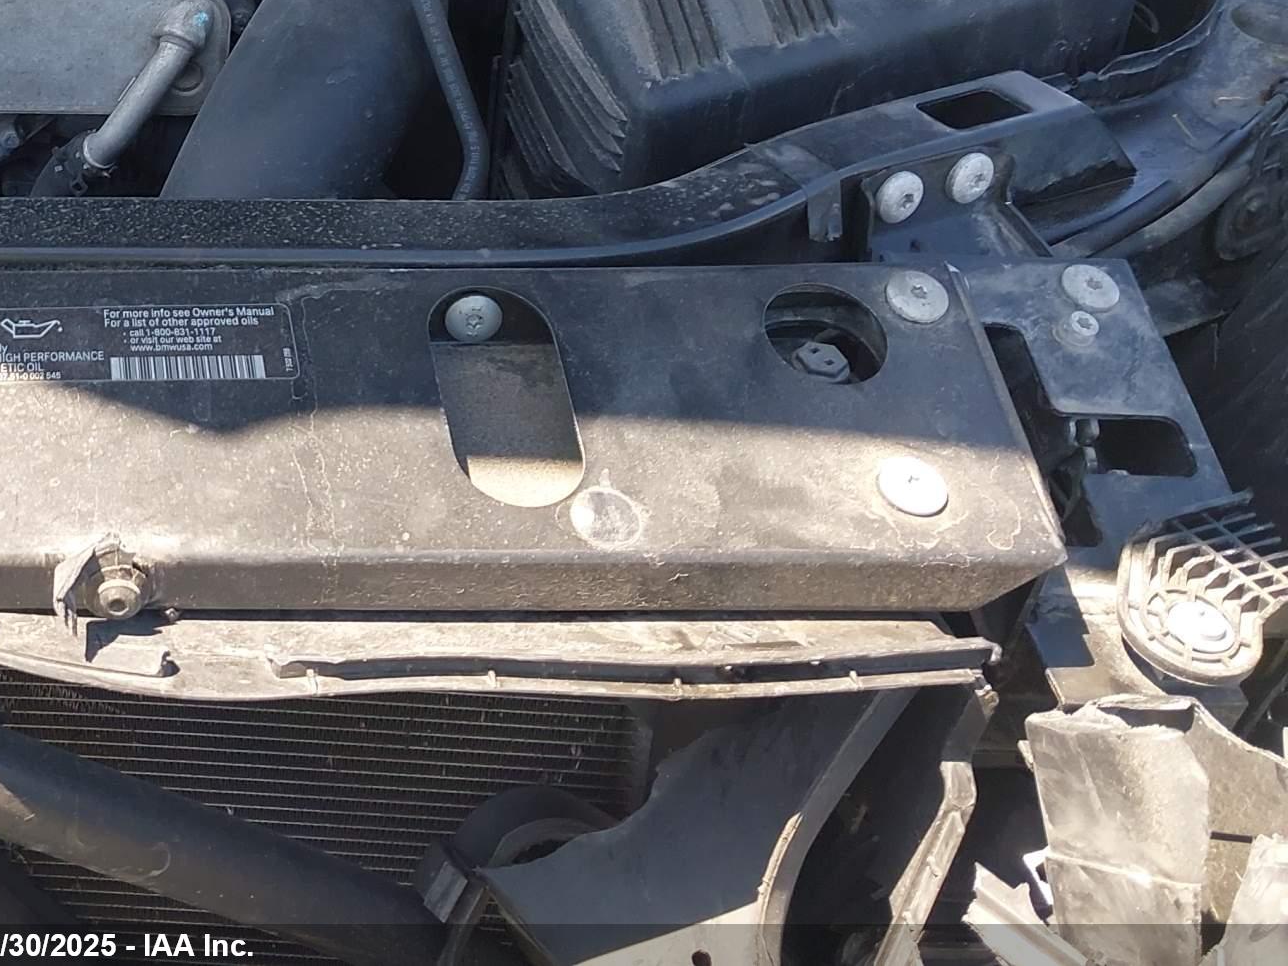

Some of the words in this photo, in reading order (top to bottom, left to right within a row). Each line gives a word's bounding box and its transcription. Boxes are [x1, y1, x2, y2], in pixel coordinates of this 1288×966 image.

[103, 309, 121, 318] For
[123, 310, 149, 318] more
[151, 309, 170, 318] info
[172, 309, 190, 317] see
[192, 308, 234, 316] Owner's
[236, 307, 274, 316] Manual
[104, 319, 122, 328] For
[132, 318, 146, 327] list
[149, 318, 160, 326] of
[162, 317, 188, 326] other
[191, 317, 239, 328] approved
[241, 316, 259, 325] oils
[146, 328, 216, 336] 1-800-831-1117
[141, 336, 158, 344] visit
[196, 335, 211, 343] site
[130, 343, 213, 352] www.bmwusa.com
[23, 351, 104, 362] PERFORMANCE
[26, 362, 44, 372] OIL
